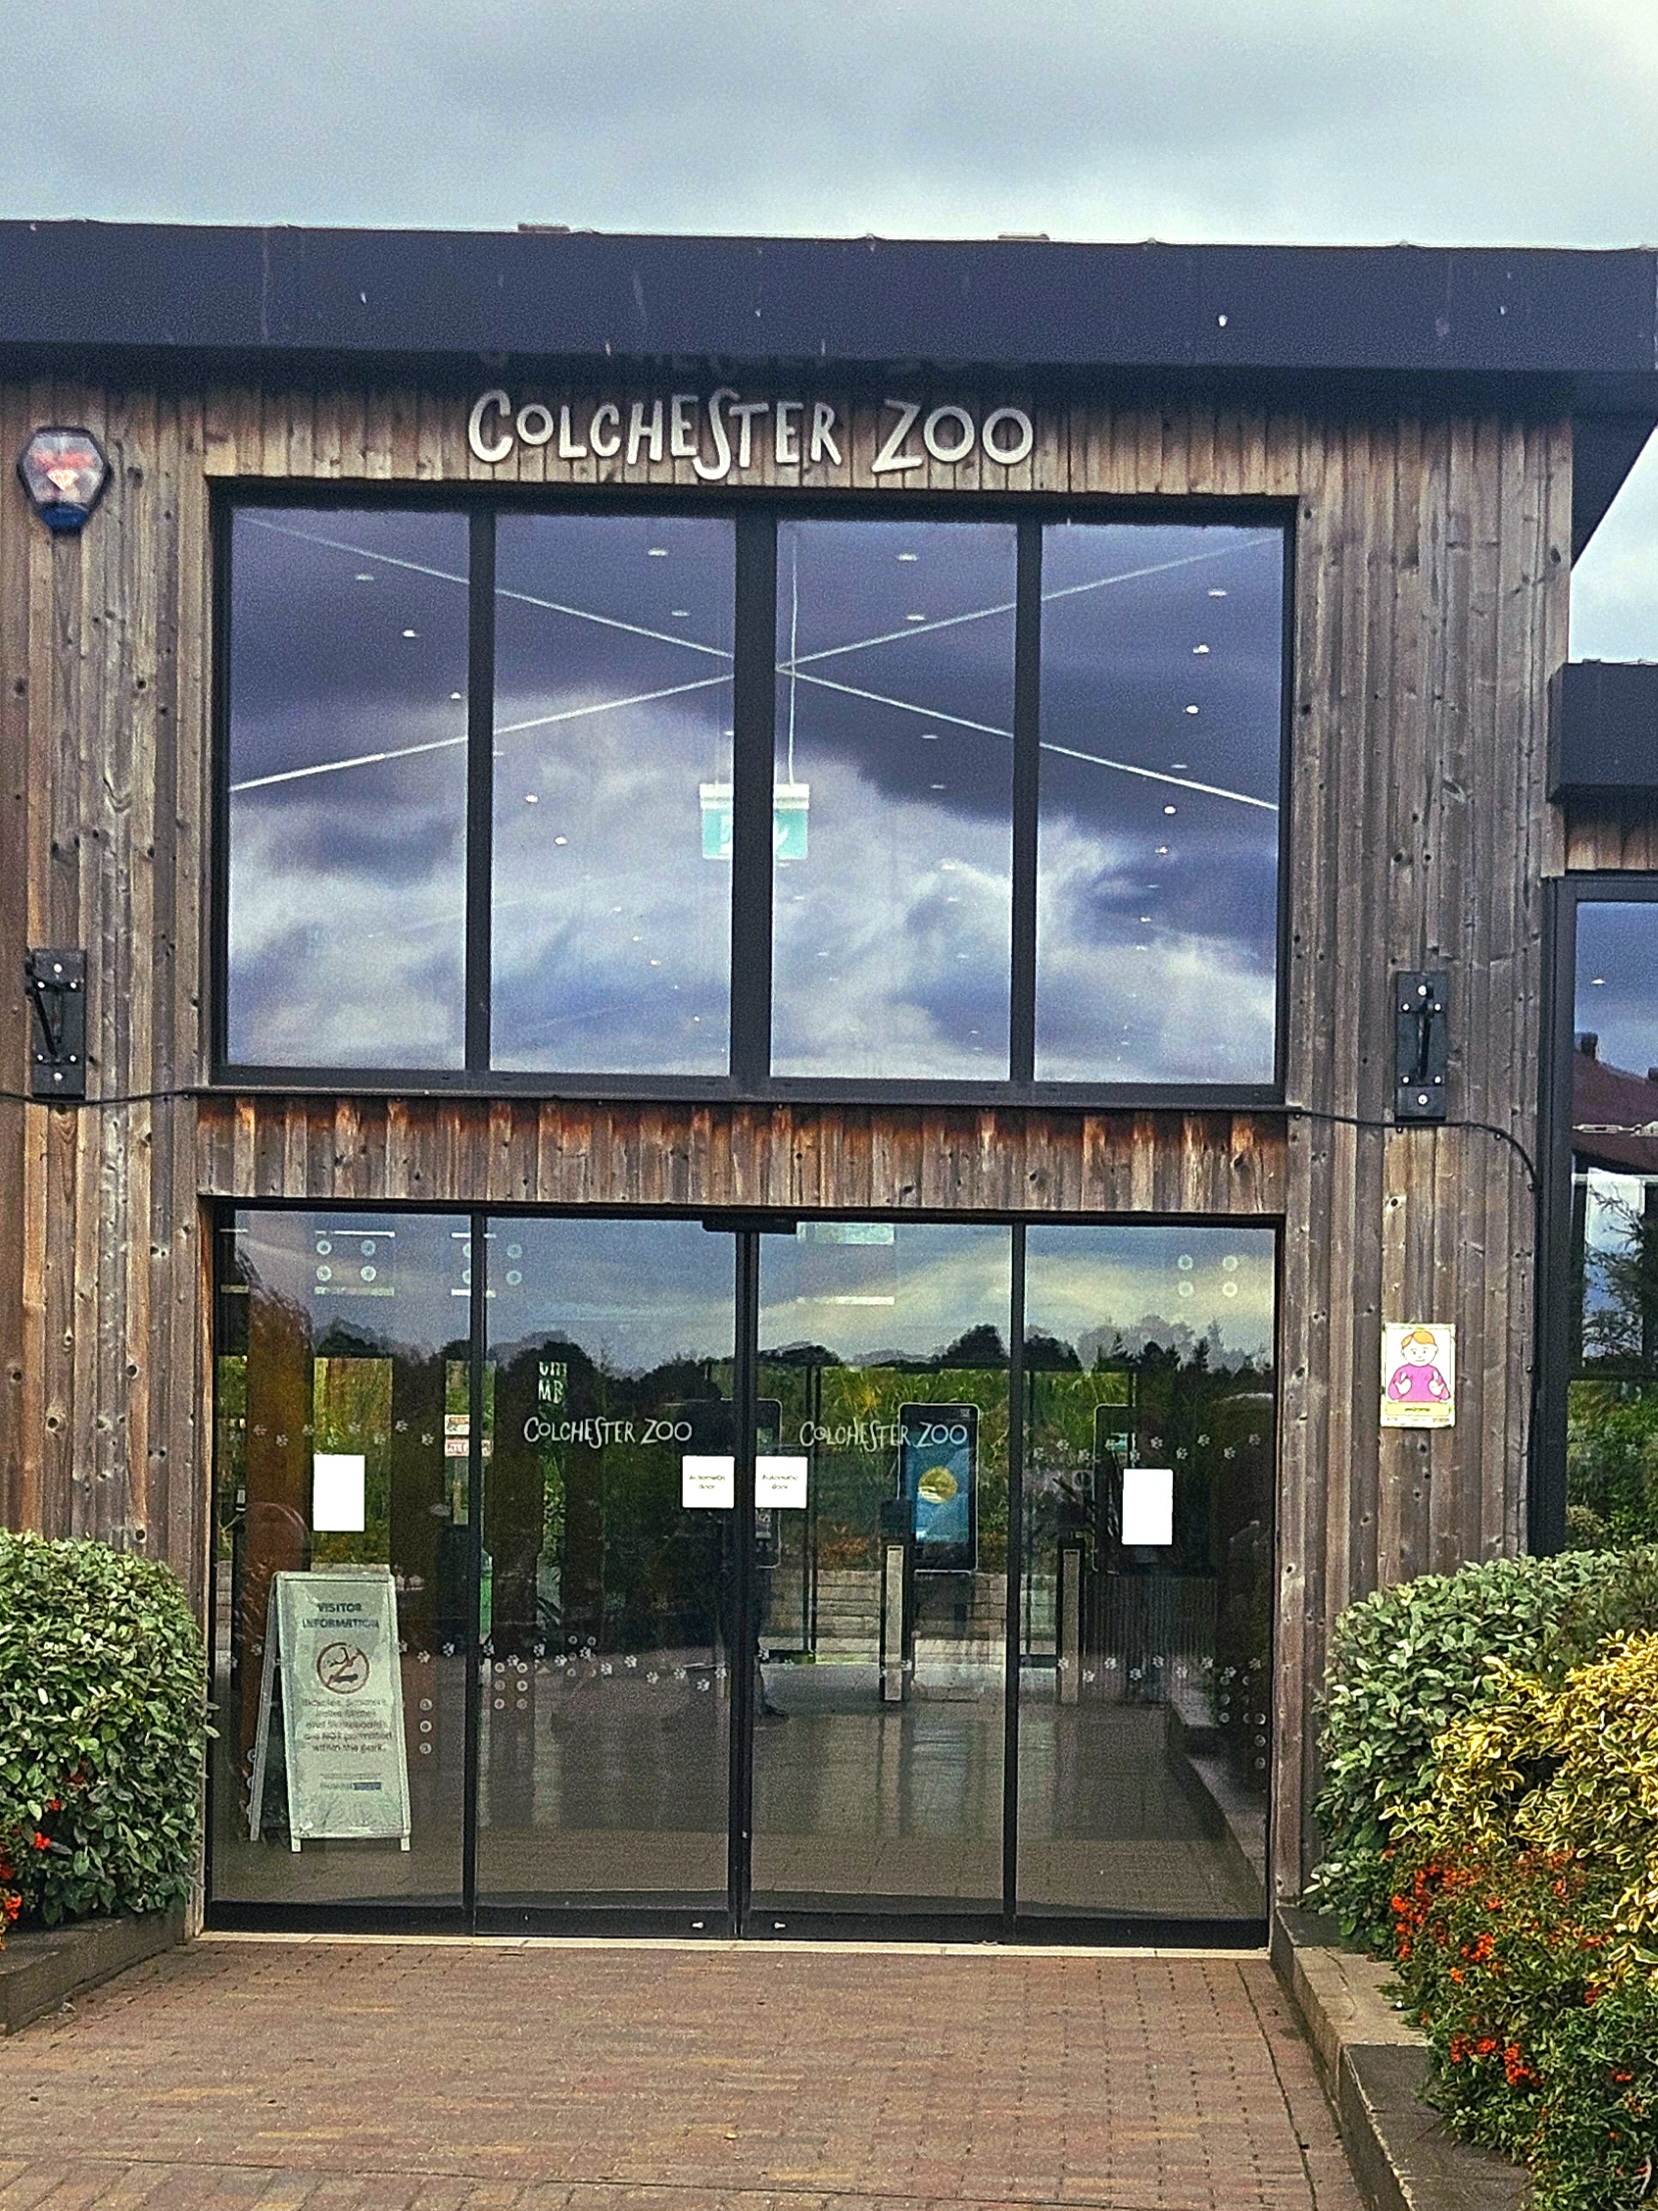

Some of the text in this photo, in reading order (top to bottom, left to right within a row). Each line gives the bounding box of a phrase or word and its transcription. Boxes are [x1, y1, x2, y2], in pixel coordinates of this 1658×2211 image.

[468, 389, 1034, 481] COLCHESTER ZOO
[524, 1416, 693, 1449] COLCHESTER ZOO
[799, 1419, 968, 1452] COLCHESTER ZOO
[302, 1618, 379, 1629] INFORMATION
[317, 1602, 362, 1613] VISITOR
